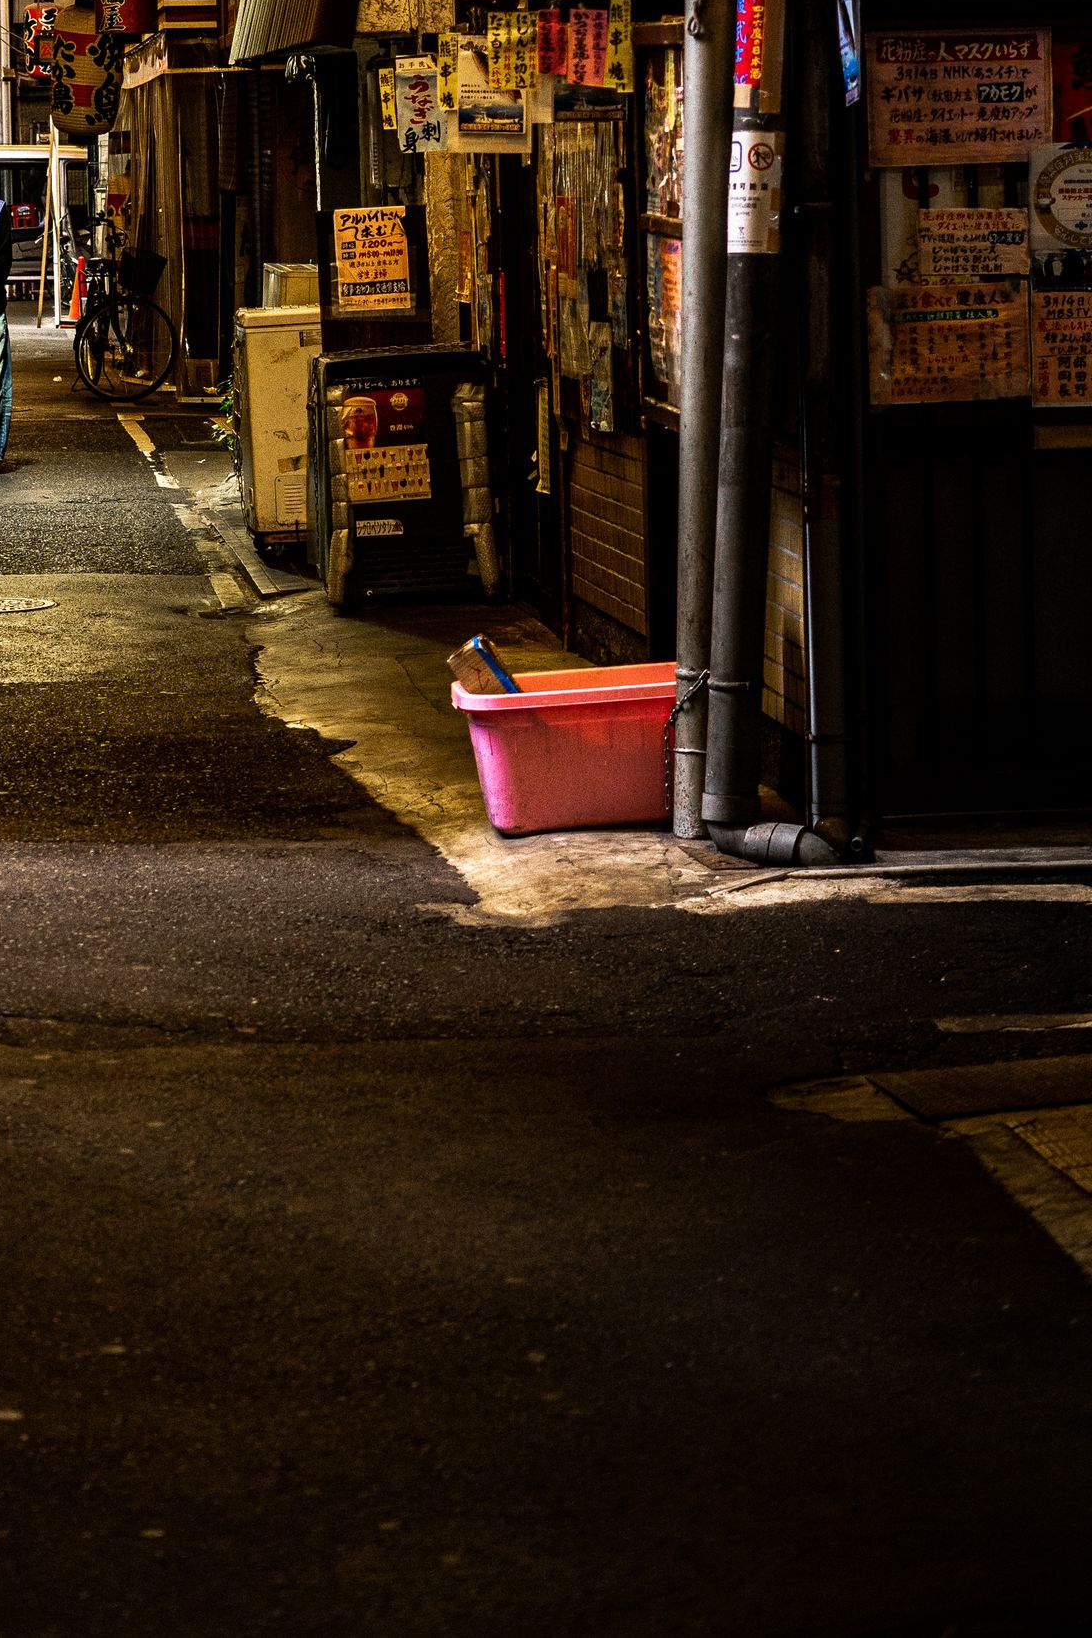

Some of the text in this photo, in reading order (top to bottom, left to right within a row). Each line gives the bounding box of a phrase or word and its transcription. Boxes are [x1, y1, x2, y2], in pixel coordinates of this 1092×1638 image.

[404, 73, 435, 125] うなぎ
[339, 209, 402, 226] アルバイトさん
